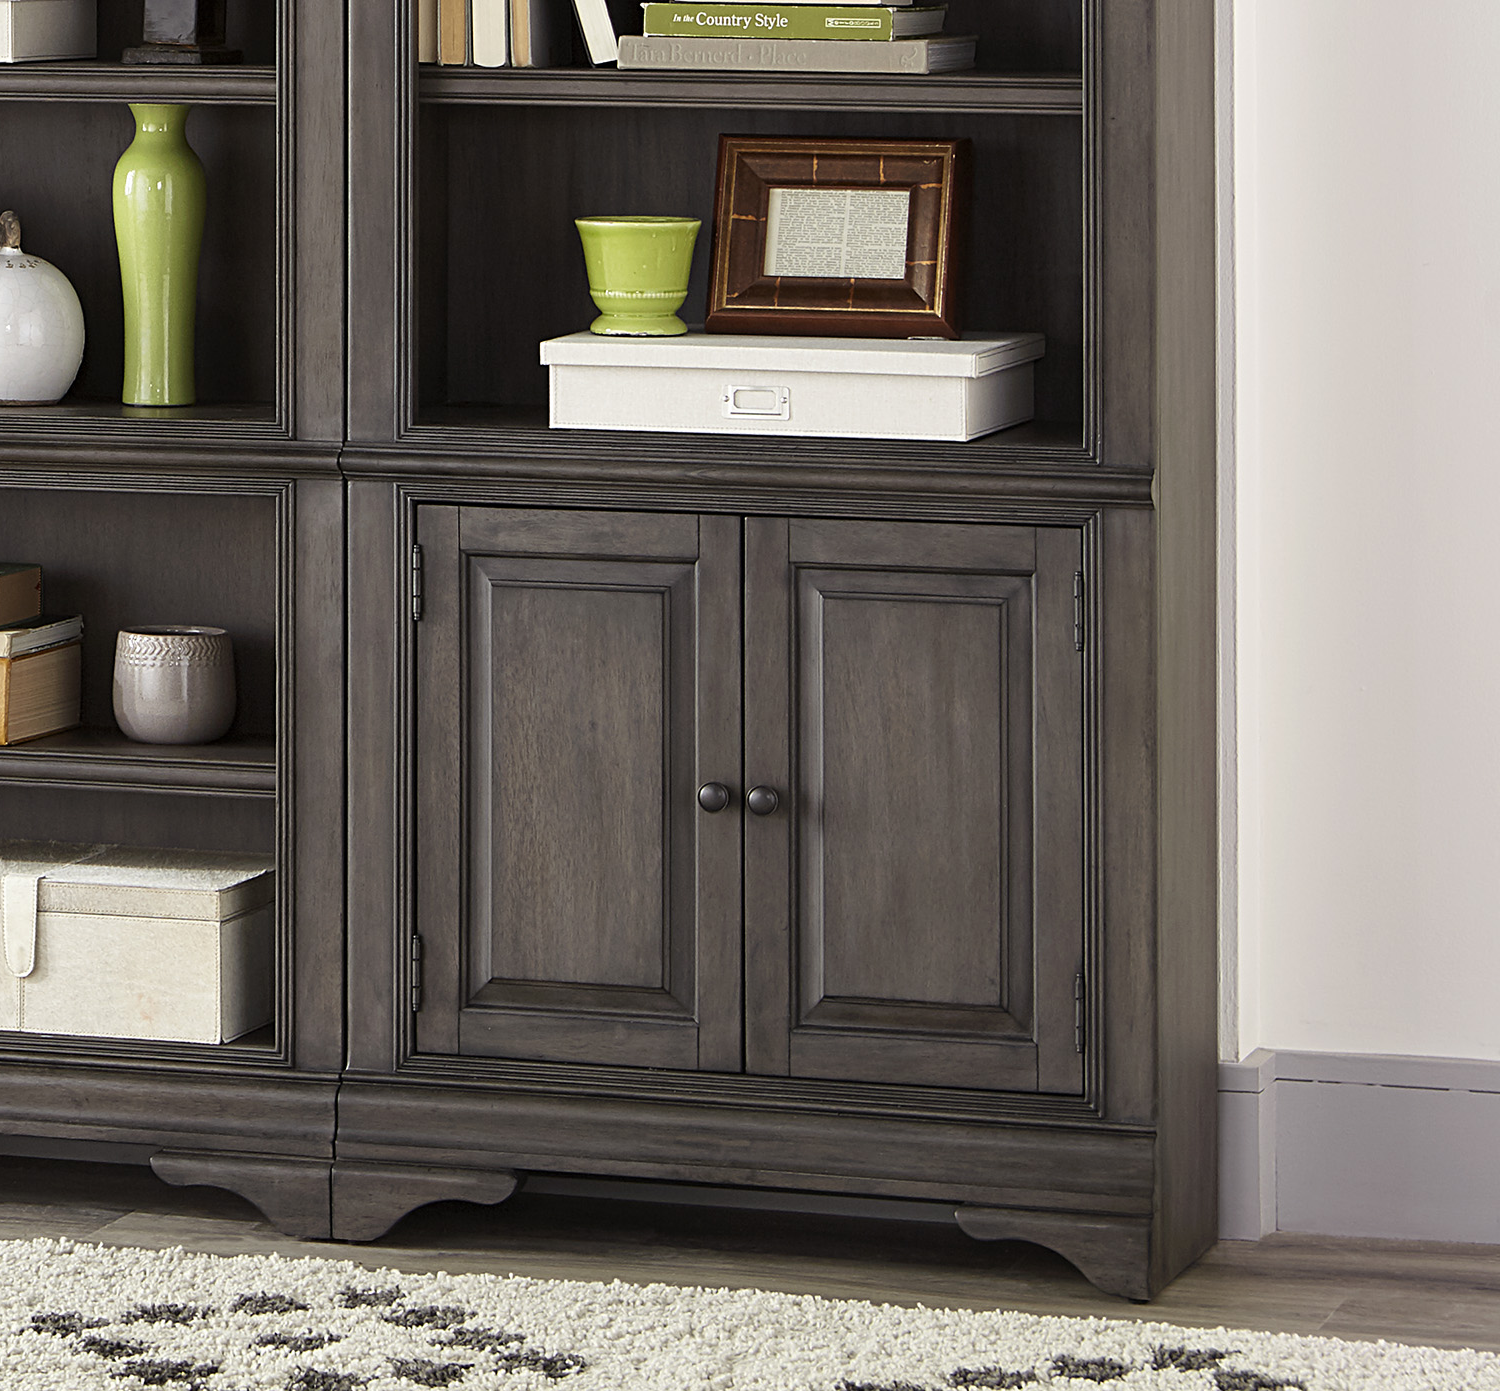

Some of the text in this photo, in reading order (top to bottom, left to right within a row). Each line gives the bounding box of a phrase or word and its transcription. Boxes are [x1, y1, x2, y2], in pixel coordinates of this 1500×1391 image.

[673, 12, 789, 30] In the Country Style
[758, 44, 807, 65] Place
